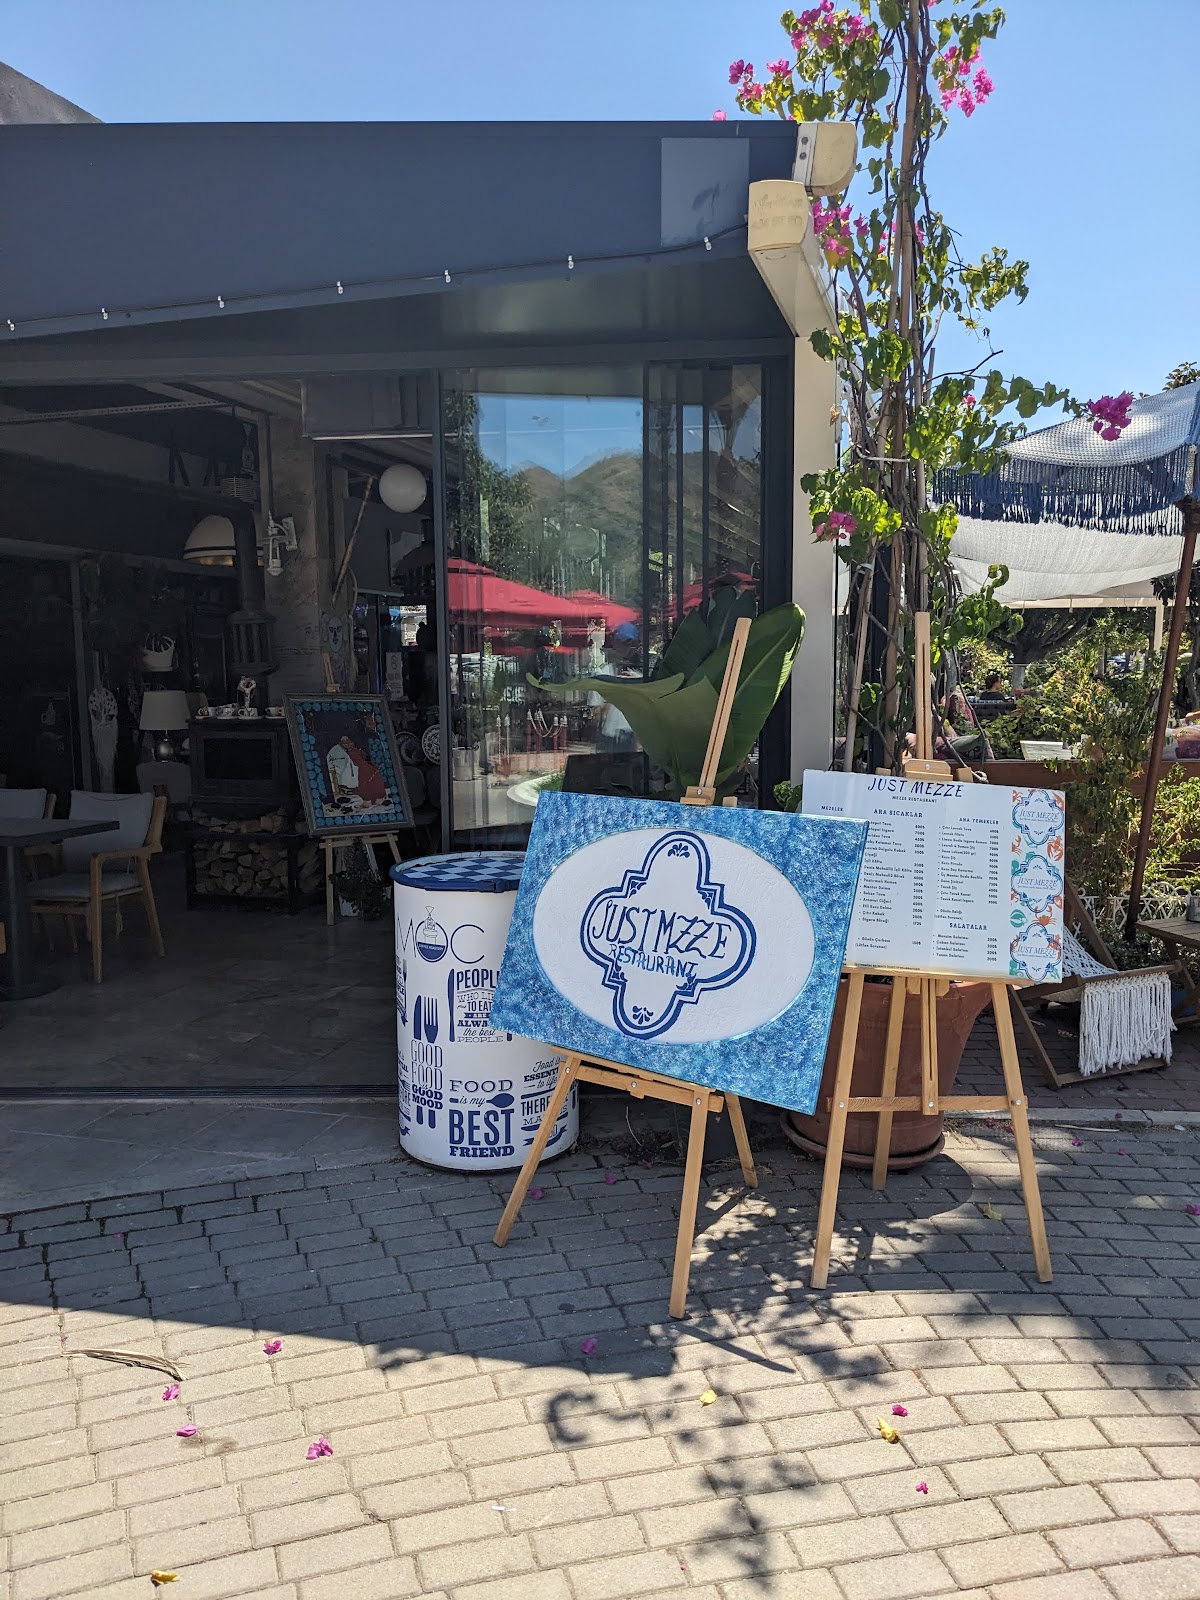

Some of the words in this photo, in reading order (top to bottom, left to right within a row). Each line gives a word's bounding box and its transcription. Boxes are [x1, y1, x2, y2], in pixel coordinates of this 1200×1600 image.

[867, 778, 908, 793] JUST
[910, 782, 964, 798] MEZZE
[908, 796, 937, 804] RESTAURANT
[889, 810, 923, 818] SICAKLAR
[1018, 808, 1035, 818] JUST
[1036, 811, 1060, 822] MEZZE
[1016, 876, 1034, 885] JUST
[1034, 878, 1058, 889] MEZZE
[592, 899, 657, 952] JUST
[949, 922, 988, 930] SALATALAR
[1016, 945, 1034, 954] JUST
[1034, 948, 1057, 958] MEZZE
[608, 943, 699, 978] RESTAURANT
[456, 992, 480, 1003] WHO
[467, 1000, 477, 1012] TO
[478, 1000, 492, 1012] EAT
[462, 1027, 476, 1036] the
[478, 1027, 498, 1036] best
[410, 1039, 443, 1068] GOOD
[532, 1057, 556, 1072] Food
[411, 1060, 443, 1090] FOOD
[449, 1080, 513, 1093] FOOD
[537, 1080, 545, 1089] to
[412, 1084, 444, 1101] GOOD
[412, 1094, 444, 1110] MOOD
[459, 1096, 468, 1105] is
[468, 1097, 486, 1108] my
[449, 1108, 515, 1146] BEST
[449, 1145, 515, 1158] FRIEND
